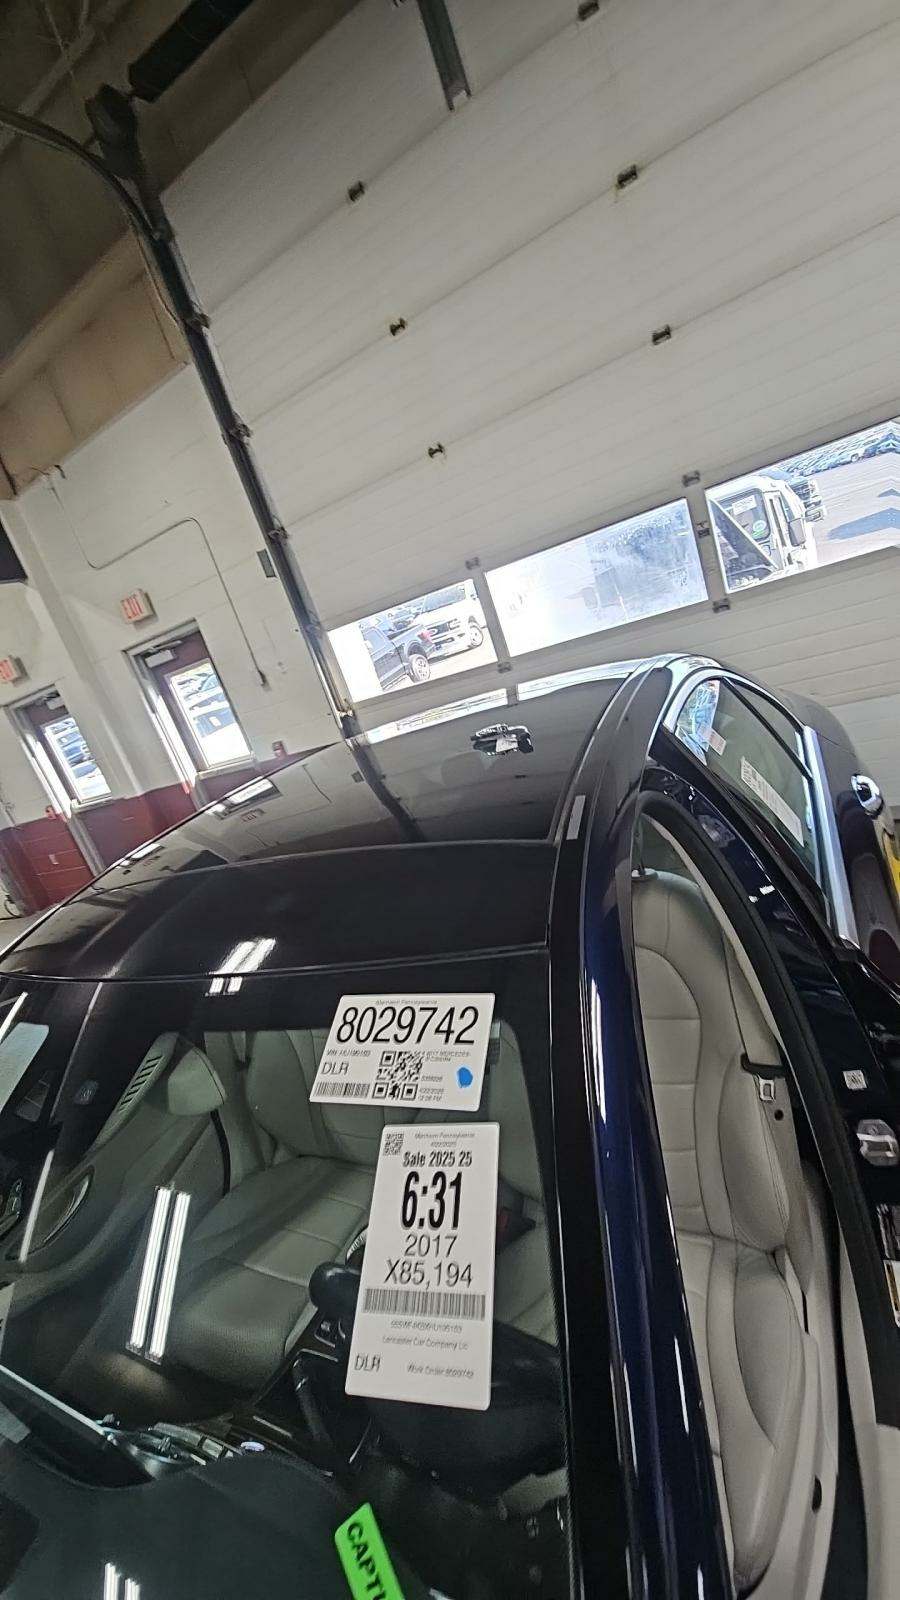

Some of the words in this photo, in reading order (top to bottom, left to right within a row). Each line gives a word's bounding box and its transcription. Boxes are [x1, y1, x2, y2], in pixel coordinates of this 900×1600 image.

[336, 1006, 479, 1045] 8029742
[321, 1062, 350, 1076] DLR
[403, 1151, 426, 1167] Sale
[428, 1151, 456, 1167] 2025
[458, 1150, 473, 1167] 25
[401, 1170, 463, 1230] 6:31
[404, 1233, 458, 1258] 2017
[384, 1258, 474, 1291] X85,194
[354, 1355, 381, 1373] DLR
